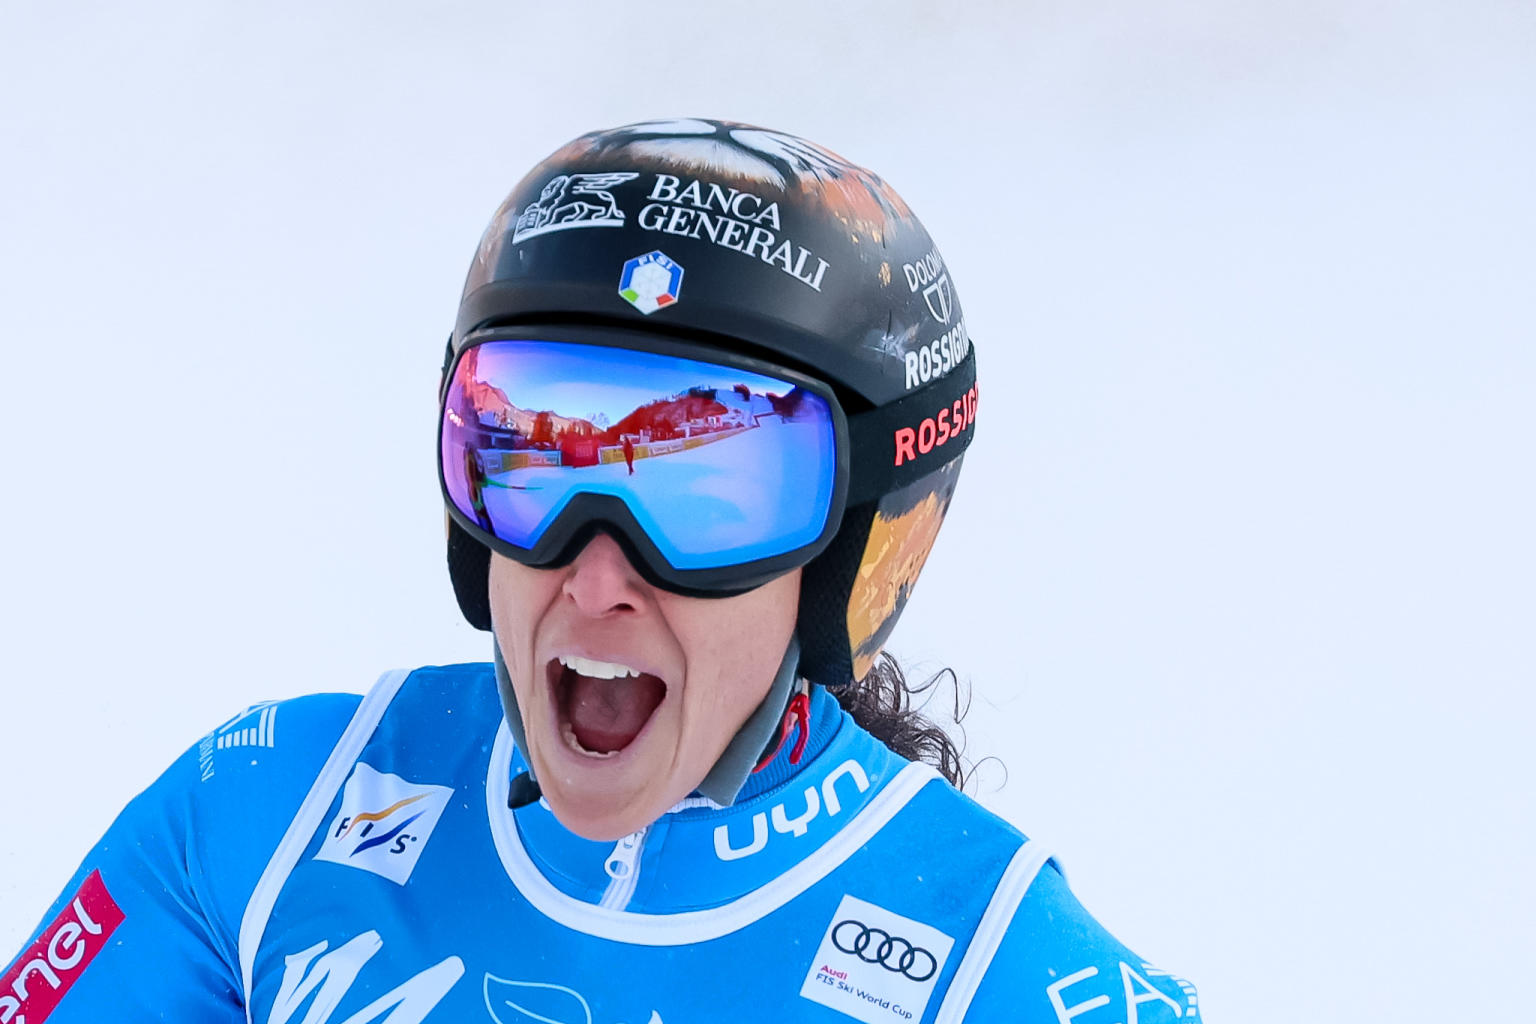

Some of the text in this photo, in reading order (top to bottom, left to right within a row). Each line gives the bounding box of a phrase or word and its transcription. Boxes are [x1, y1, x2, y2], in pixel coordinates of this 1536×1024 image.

[646, 173, 781, 232] BANCA
[638, 203, 831, 293] GENERALI
[335, 816, 410, 854] FIS
[820, 965, 848, 980] Audi
[816, 973, 913, 1019] FIS Ski World Cup
